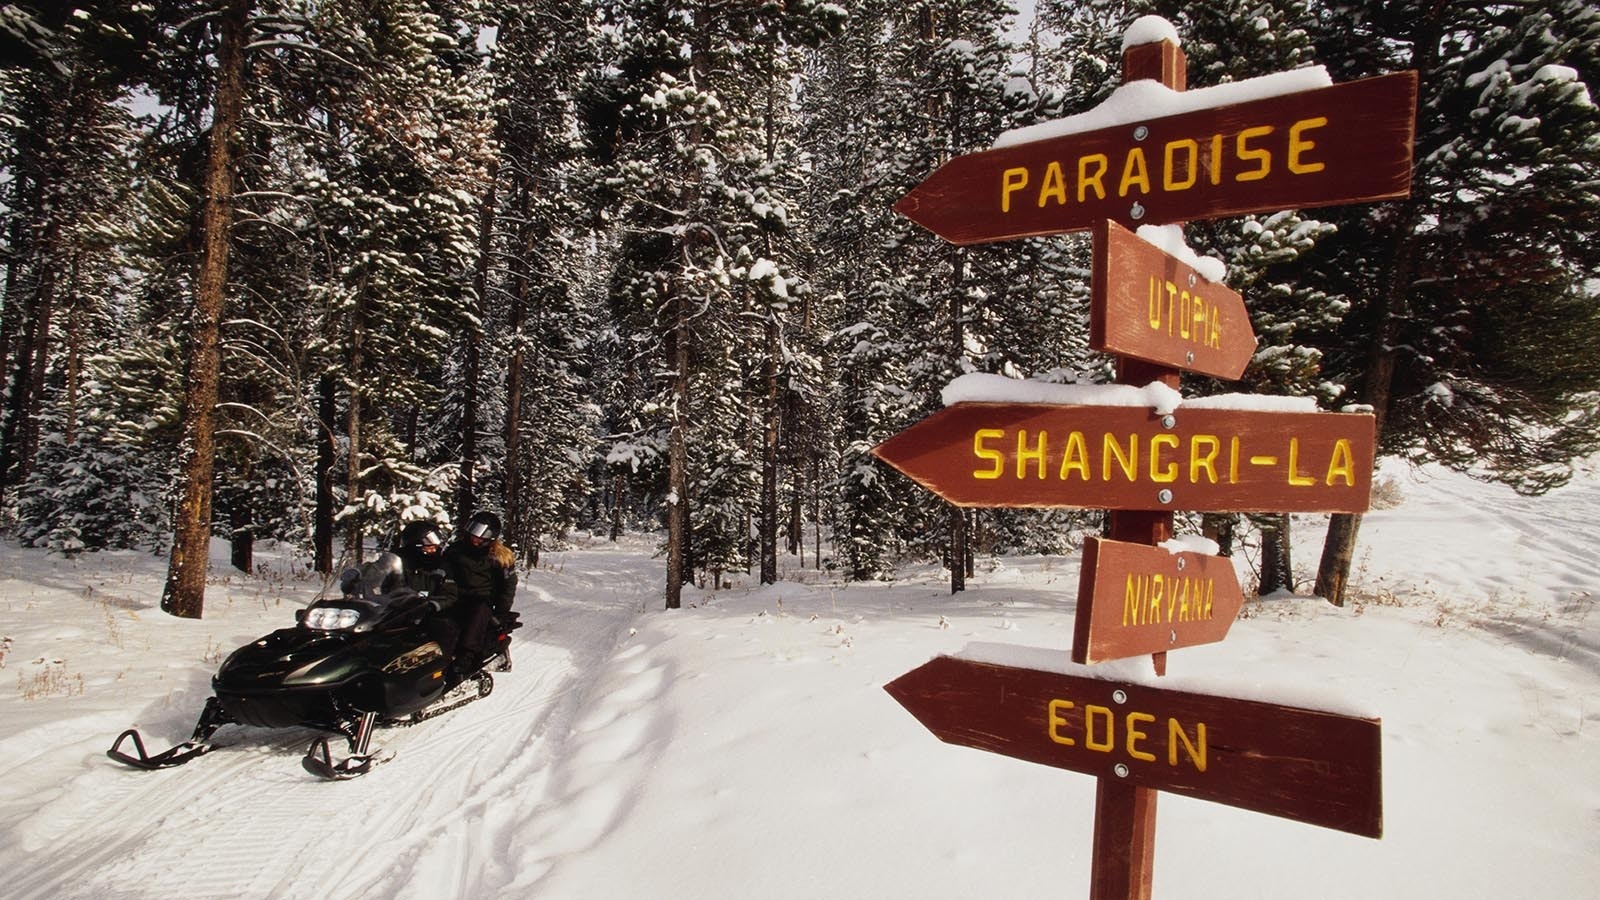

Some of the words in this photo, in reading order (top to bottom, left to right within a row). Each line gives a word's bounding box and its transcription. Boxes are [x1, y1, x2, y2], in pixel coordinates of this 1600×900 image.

[1002, 117, 1327, 212] PARADISE
[1149, 276, 1221, 350] UTOPIA
[973, 428, 1355, 487] SHANGRI-LA
[1123, 573, 1213, 626] NIRVANA
[1049, 699, 1207, 771] EDEN
